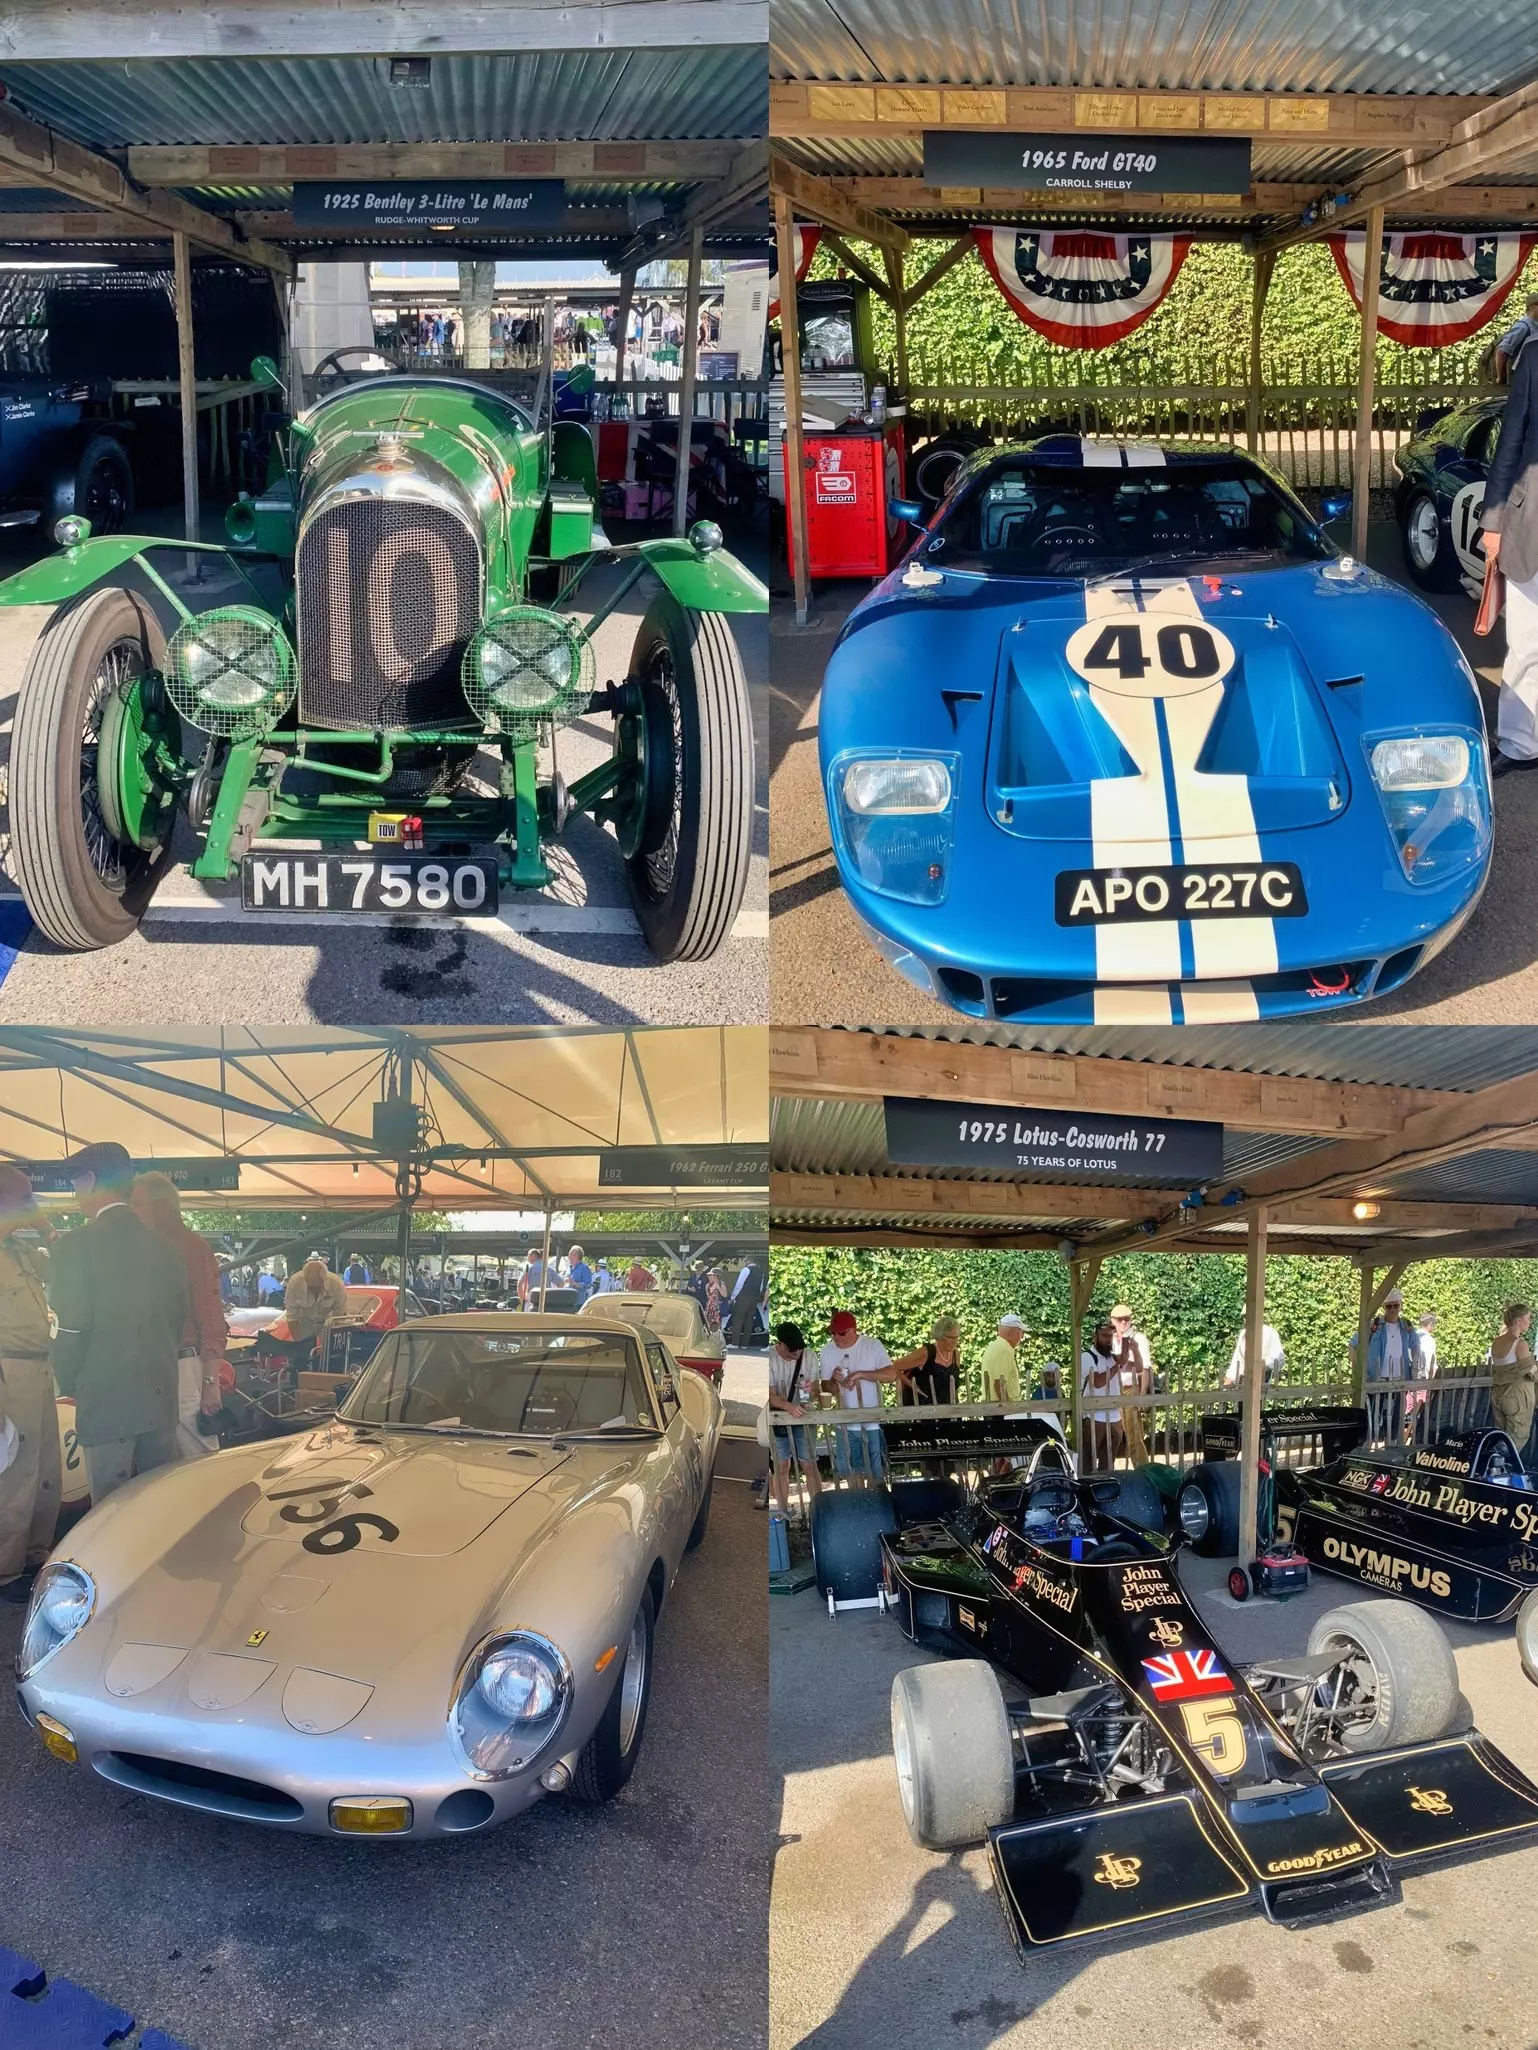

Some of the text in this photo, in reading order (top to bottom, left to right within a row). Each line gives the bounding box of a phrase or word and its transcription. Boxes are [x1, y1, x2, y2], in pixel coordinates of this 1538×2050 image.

[1022, 150, 1157, 173] 1965 Ford GT40
[1046, 178, 1133, 189] CARROLL SHELBY
[323, 193, 533, 213] 1925 Bentley 3-Litre 'Le Mans'
[375, 216, 480, 224] RUDGE-WHITWORTH CUP
[328, 526, 458, 683] 10
[1083, 624, 1220, 679] 40
[378, 824, 396, 837] TOW
[253, 862, 486, 909] MH 7580
[1069, 870, 1293, 916] APO 227C
[958, 1120, 1166, 1152] 1975 Lotus-Cosworth 77
[669, 1161, 769, 1173] 1962 Ferrari 250 G
[1017, 1155, 1117, 1170] 75 YEARS OF LOTUS
[174, 1170, 188, 1180] GTO
[221, 1176, 235, 1185] 183
[604, 1168, 622, 1178] 182
[1278, 1412, 1318, 1425] Special
[898, 1435, 1033, 1447] John Player Special
[1445, 1438, 1464, 1448] Mario
[1415, 1451, 1470, 1473] Valvoline
[1344, 1471, 1372, 1484] NGK
[1384, 1476, 1431, 1507] John
[1433, 1485, 1508, 1525] Player
[266, 1480, 400, 1555] 156
[1276, 1503, 1297, 1545] 5
[1122, 1566, 1163, 1583] John
[1323, 1537, 1451, 1598] OLYMPUS
[1121, 1582, 1170, 1597] Player
[1360, 1569, 1403, 1592] CAMERAS
[1032, 1570, 1078, 1613] Special
[1121, 1592, 1182, 1612] Special
[1179, 1697, 1247, 1778] 5
